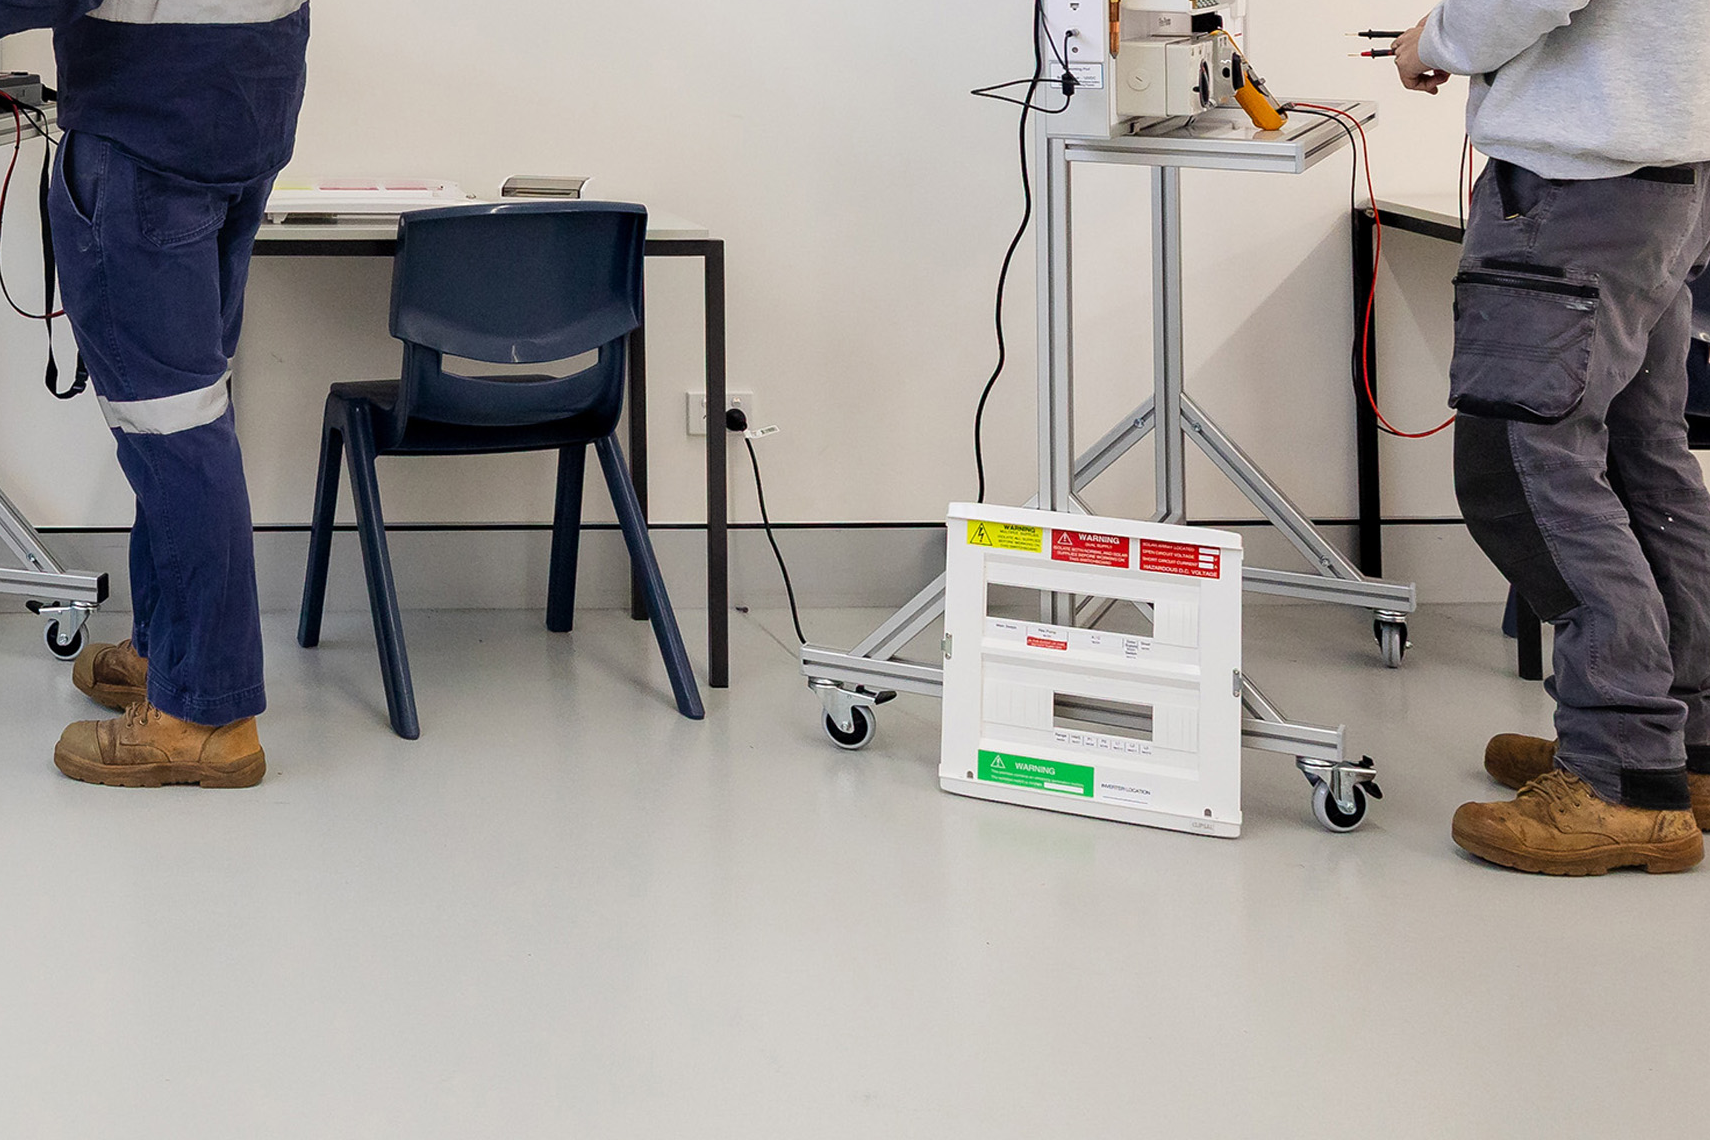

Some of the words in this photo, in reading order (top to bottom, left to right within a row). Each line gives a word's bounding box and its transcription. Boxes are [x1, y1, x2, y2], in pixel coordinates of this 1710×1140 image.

[1003, 524, 1036, 533] WARNING
[1079, 533, 1120, 544] WARNING
[1143, 564, 1178, 573] HAZARDOUS
[1191, 569, 1218, 577] VOLTAGE
[1015, 762, 1055, 775] WARNING
[1101, 783, 1125, 791] INVERTER
[1125, 787, 1151, 795] LOCATION
